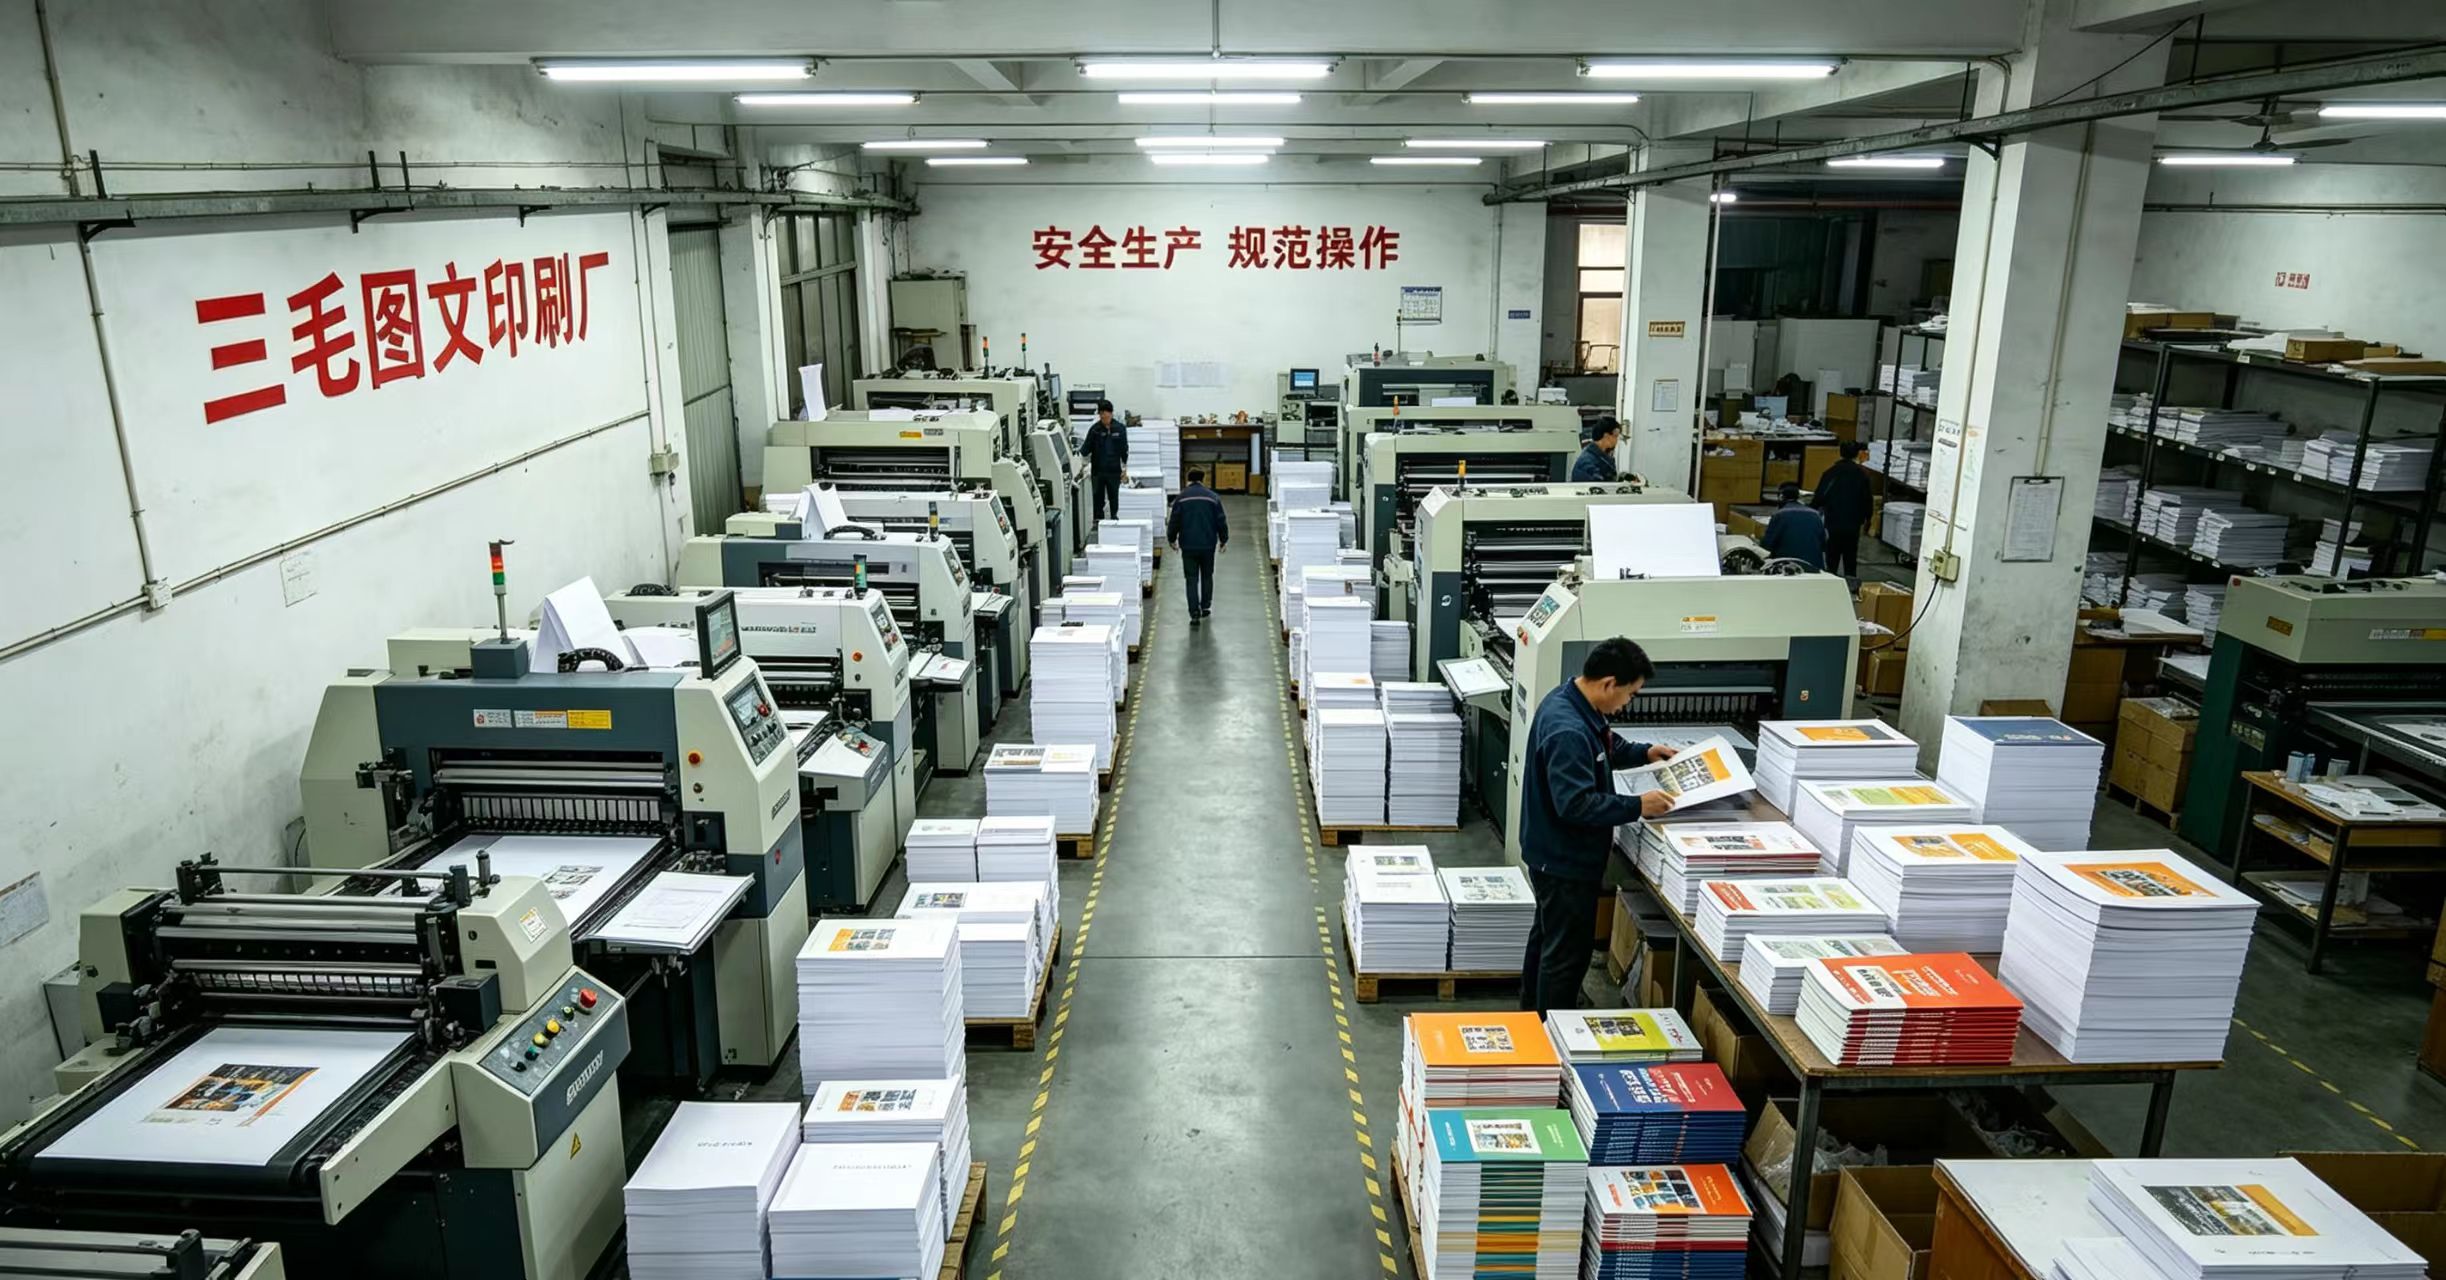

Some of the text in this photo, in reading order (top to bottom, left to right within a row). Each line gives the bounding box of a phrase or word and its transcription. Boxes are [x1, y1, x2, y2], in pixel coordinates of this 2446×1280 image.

[1032, 225, 1400, 270] 安全生产 规范操作
[195, 252, 609, 424] 三毛图文印刷厂
